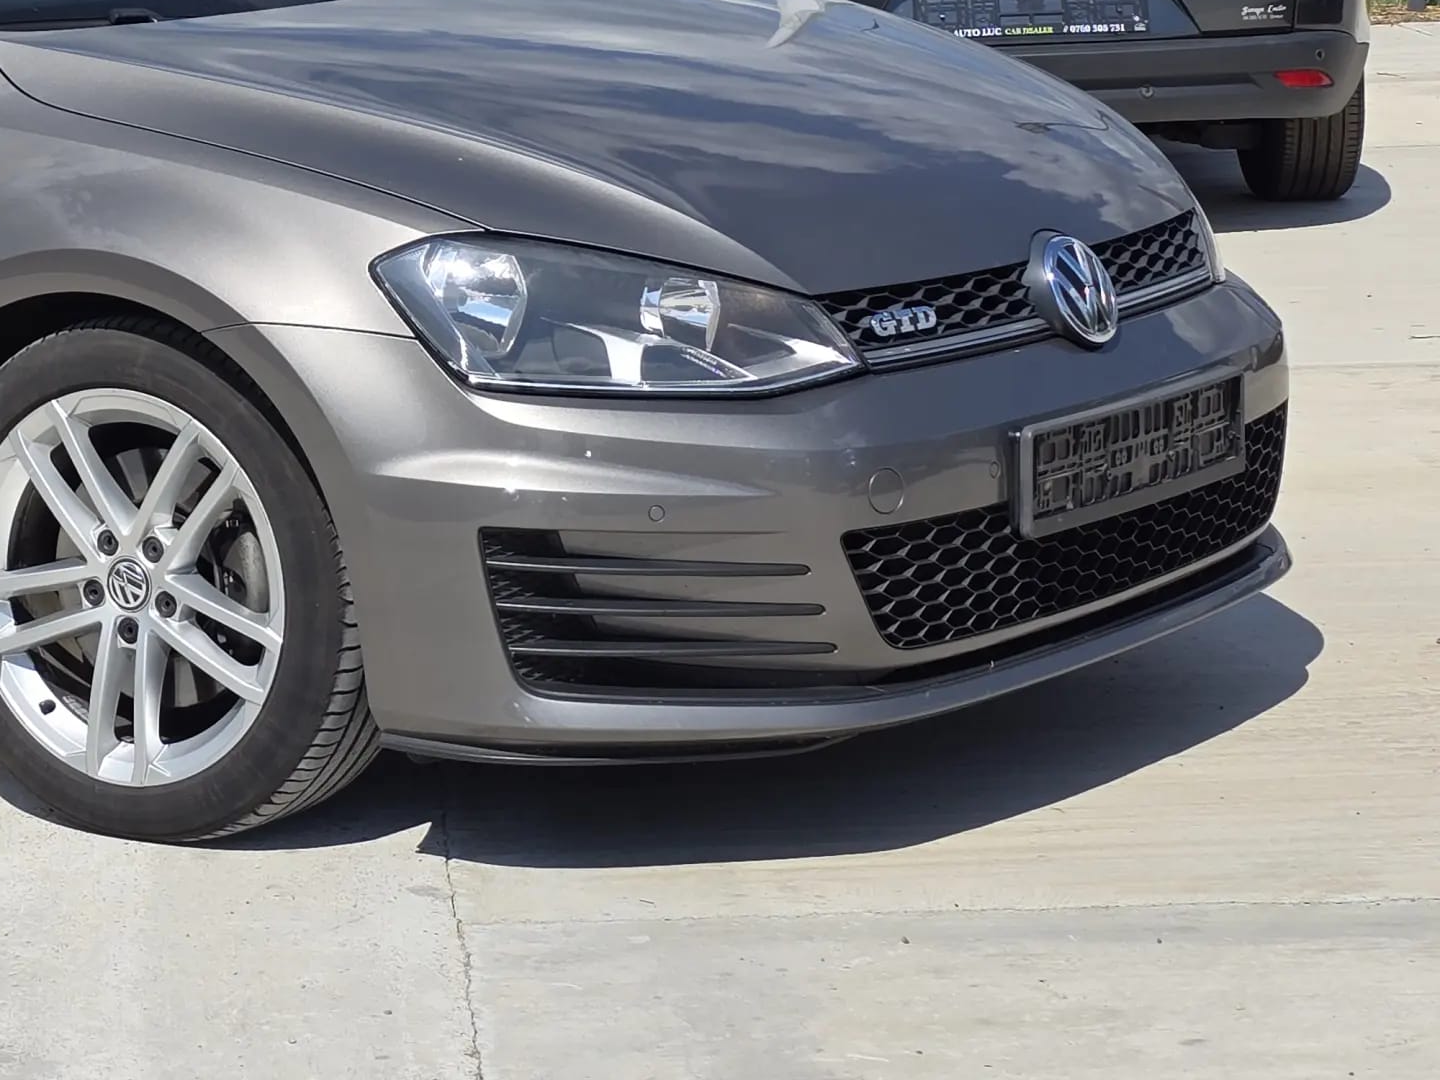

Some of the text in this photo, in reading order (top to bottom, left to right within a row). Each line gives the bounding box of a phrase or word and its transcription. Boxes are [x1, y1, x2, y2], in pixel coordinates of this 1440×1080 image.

[954, 28, 981, 38] AUTO
[982, 27, 1003, 37] LUC
[871, 305, 937, 336] GTD
